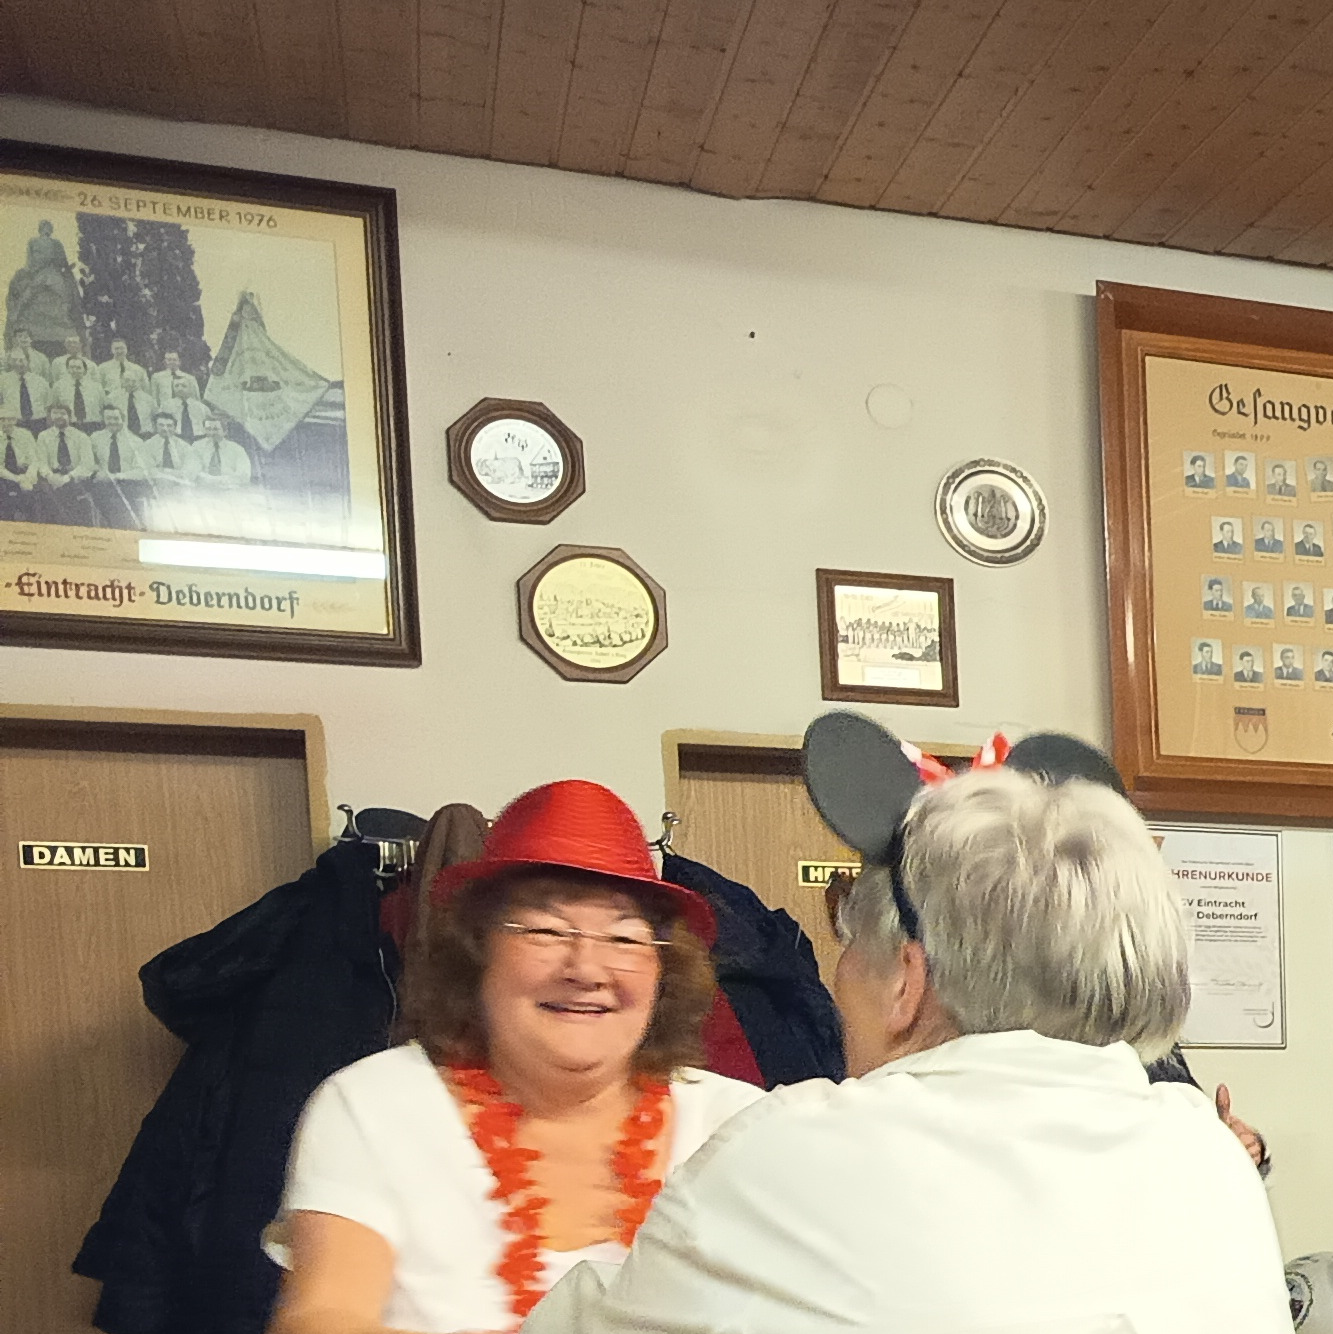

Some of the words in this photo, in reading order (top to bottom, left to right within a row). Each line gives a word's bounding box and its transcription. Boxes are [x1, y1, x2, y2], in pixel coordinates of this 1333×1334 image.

[78, 190, 103, 208] 26
[109, 197, 230, 224] SEPTEMBER
[235, 210, 279, 230] 1976
[32, 846, 137, 867] DAMEN
[1171, 868, 1273, 883] HRENURKUNDE
[1197, 898, 1246, 909] Eintracht
[1196, 911, 1258, 921] Deberndorf
